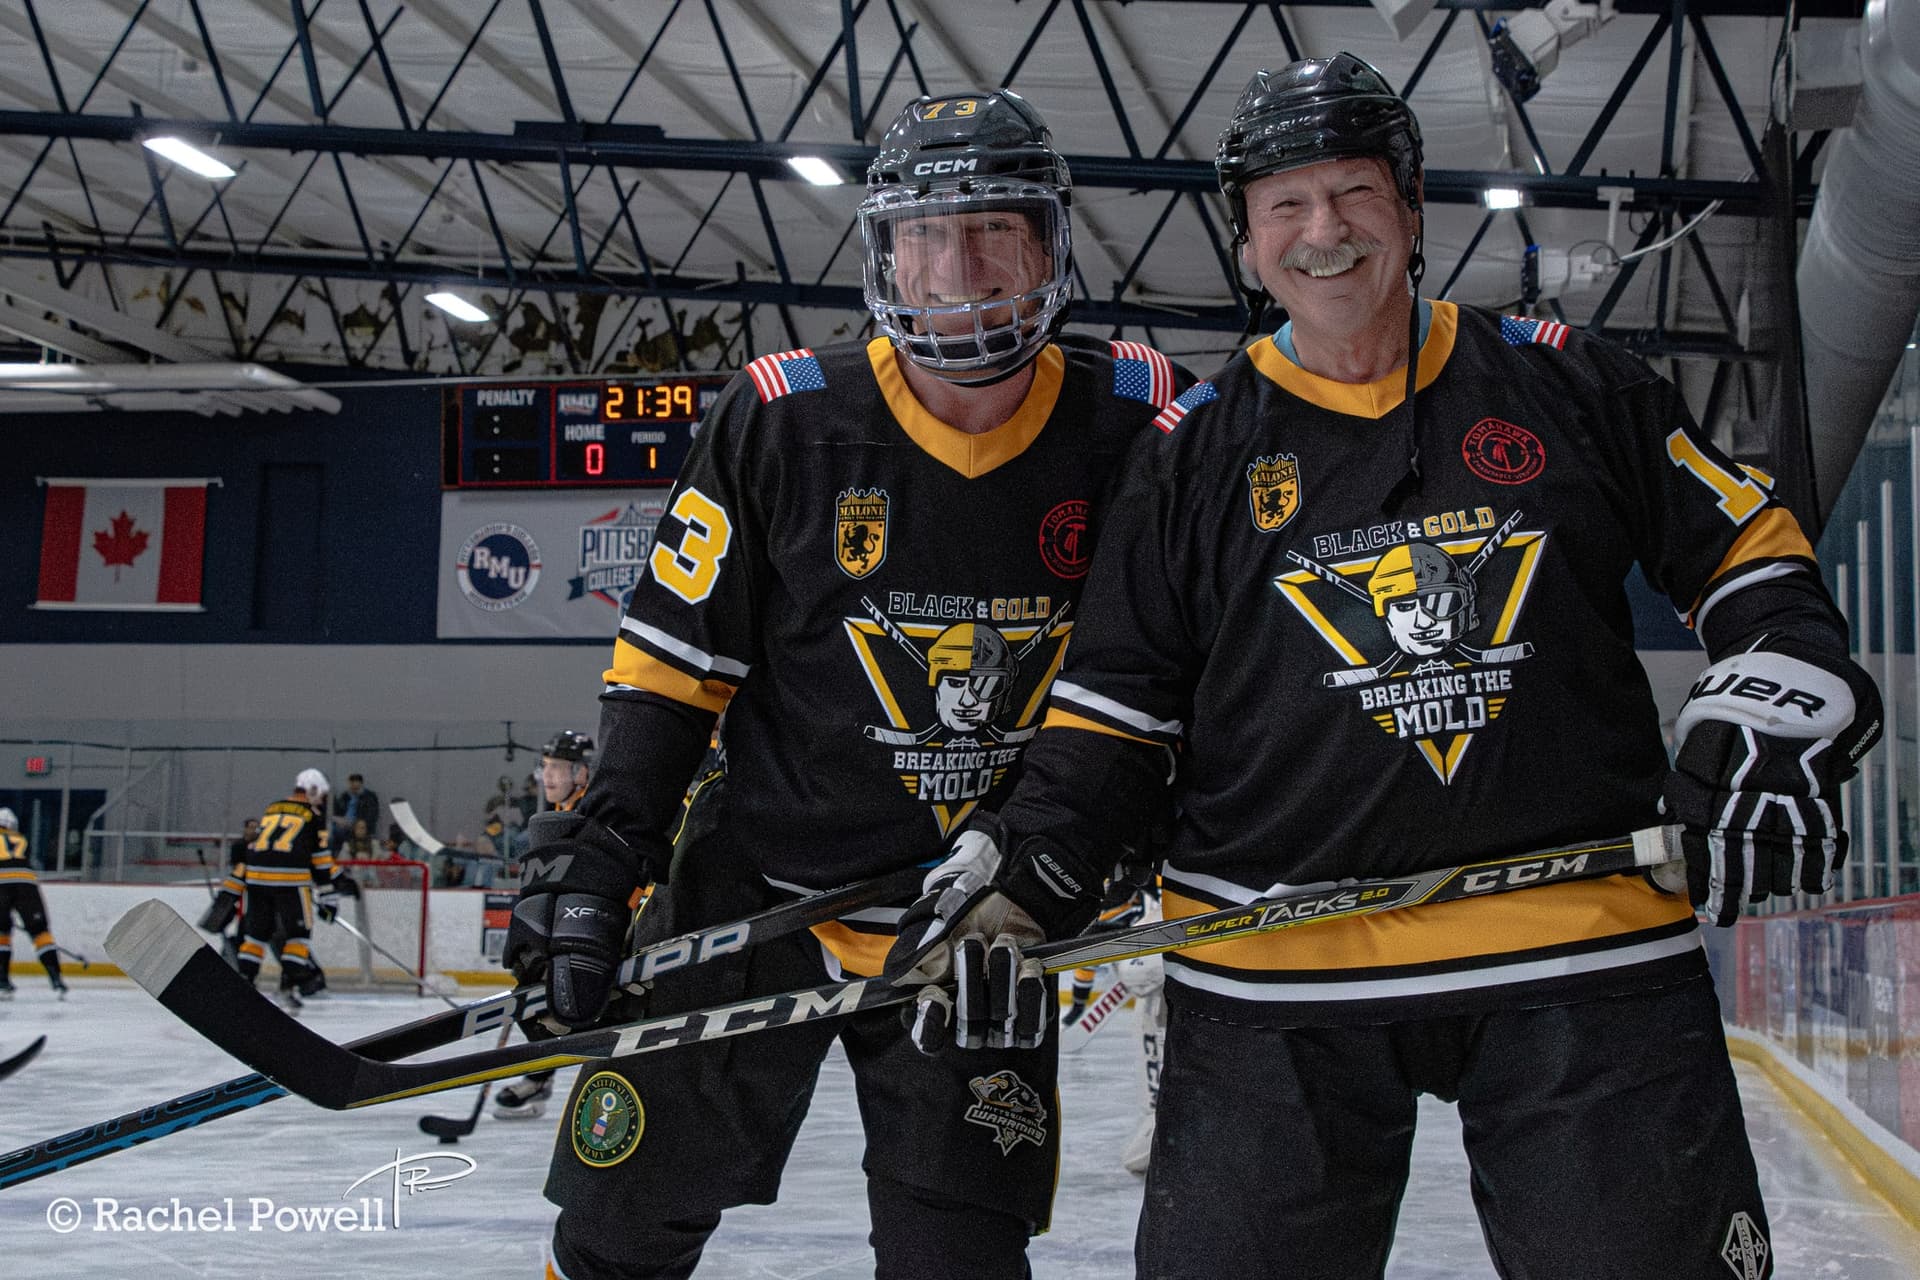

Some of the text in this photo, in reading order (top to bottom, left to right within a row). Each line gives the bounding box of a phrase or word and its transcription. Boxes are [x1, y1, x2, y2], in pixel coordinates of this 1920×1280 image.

[922, 100, 978, 120] 73
[913, 158, 978, 176] CCM
[476, 389, 536, 406] PENALTY
[605, 386, 692, 419] 21:39
[565, 424, 605, 441] HOME
[631, 431, 666, 443] PERIOD
[585, 443, 604, 475] 0
[649, 447, 657, 470] 1
[1666, 427, 1775, 527] 1
[838, 505, 886, 516] MALONE
[582, 527, 653, 569] PITTSB
[1313, 506, 1496, 558] BLACK & GOLD
[472, 546, 527, 589] RMU
[588, 567, 633, 589] COLLEGE
[888, 591, 1051, 620] BLACK & GOLD
[1359, 669, 1513, 710] BREAKING THE
[1393, 695, 1487, 739] MOLD
[893, 747, 1021, 771] BREAKING THE
[918, 771, 992, 801] MOLD
[254, 813, 305, 853] 77
[1463, 853, 1590, 893] CCM
[1186, 914, 1253, 937] SUPER
[1253, 891, 1360, 931] TACKS
[1360, 887, 1390, 900] 2.0
[609, 980, 867, 1058] CCM
